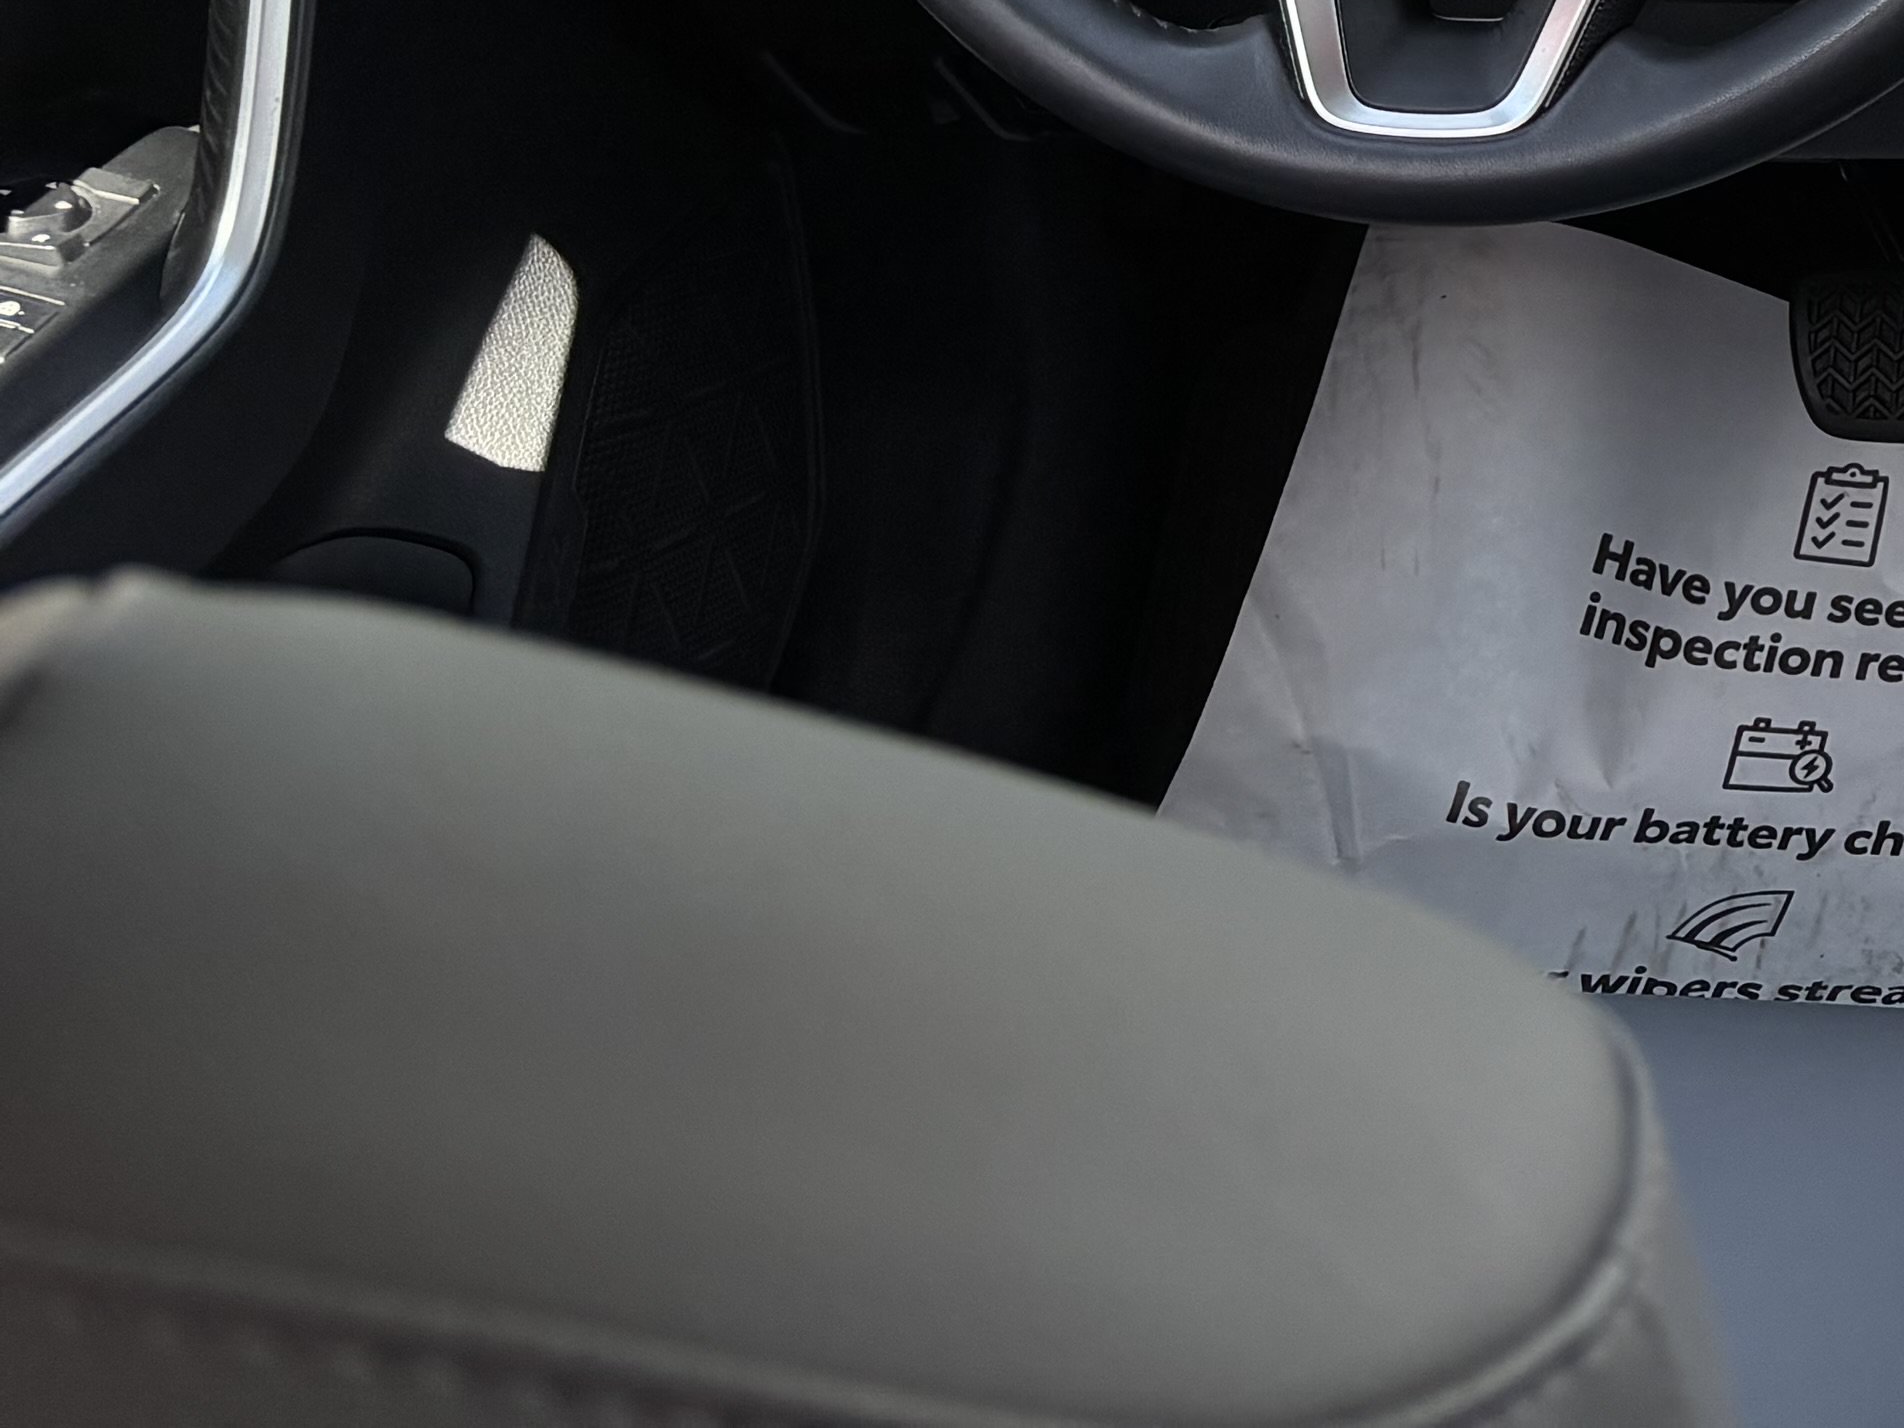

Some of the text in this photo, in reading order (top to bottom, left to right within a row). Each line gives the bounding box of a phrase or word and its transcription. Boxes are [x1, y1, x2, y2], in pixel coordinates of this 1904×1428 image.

[1594, 533, 1711, 606] Have
[1724, 578, 1816, 623] you
[1579, 593, 1844, 680] inspection
[1446, 780, 1490, 829] Is
[1497, 803, 1625, 845] your
[1634, 807, 1834, 861] battery
